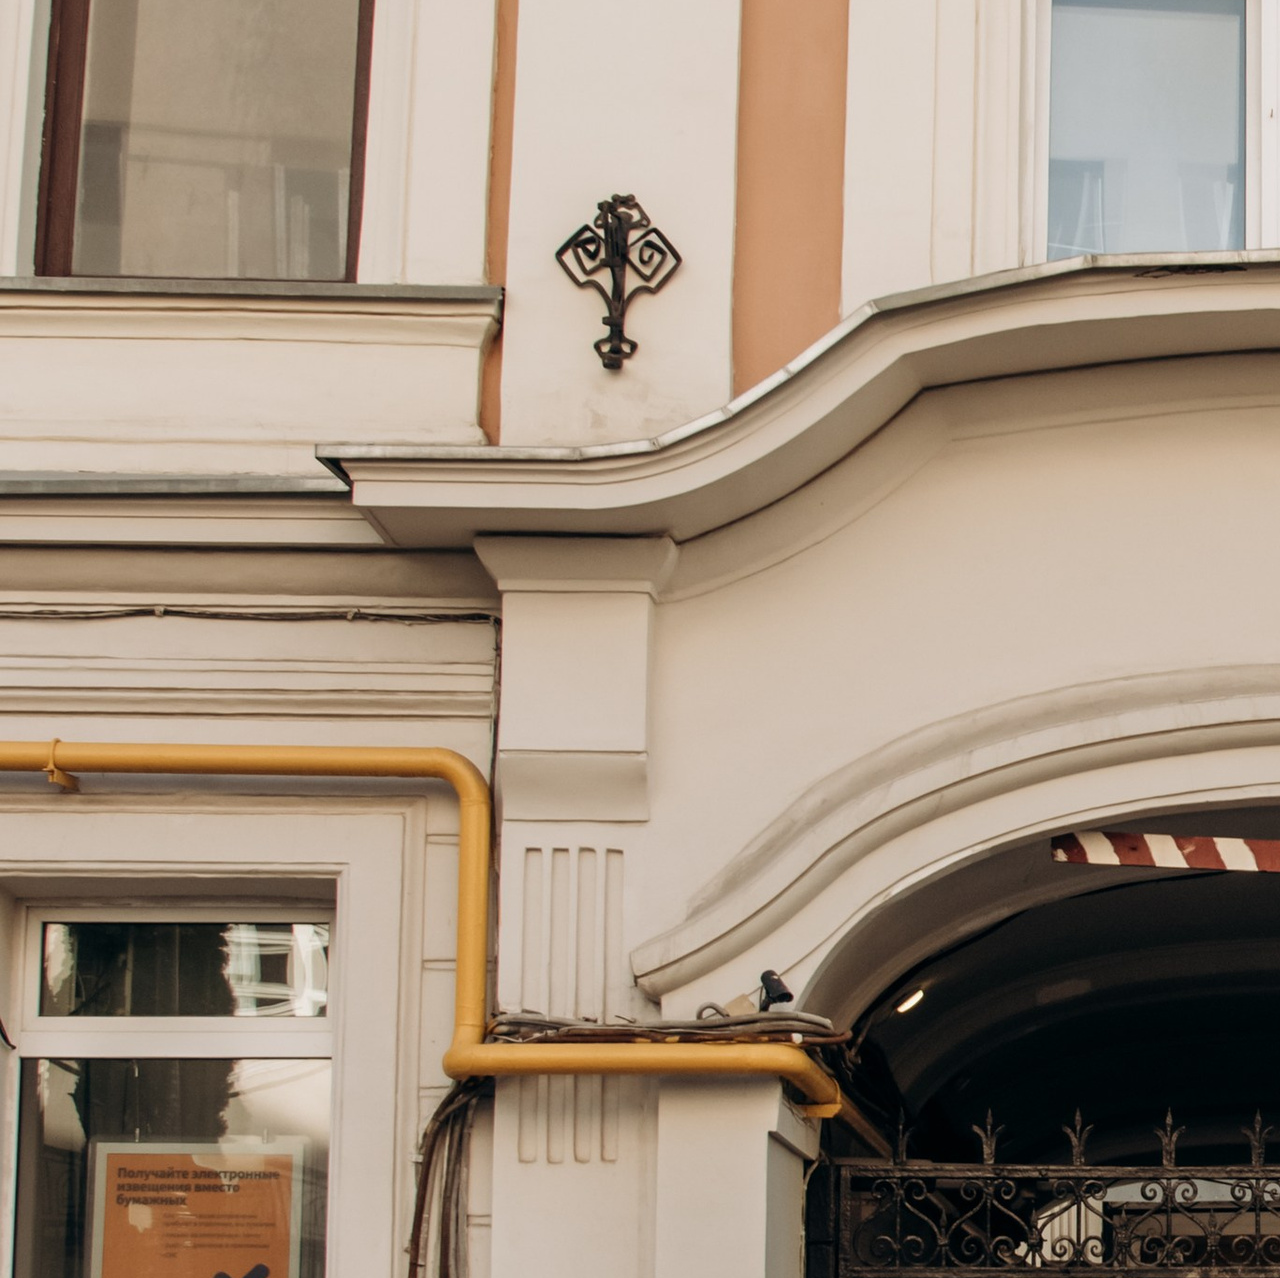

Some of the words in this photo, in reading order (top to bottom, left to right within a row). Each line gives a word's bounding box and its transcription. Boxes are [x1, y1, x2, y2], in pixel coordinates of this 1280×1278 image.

[117, 1166, 190, 1181] Получайте
[191, 1169, 280, 1182] электронные
[116, 1183, 191, 1194] извещения
[194, 1183, 240, 1193] вместо
[116, 1193, 187, 1207] бумажных
